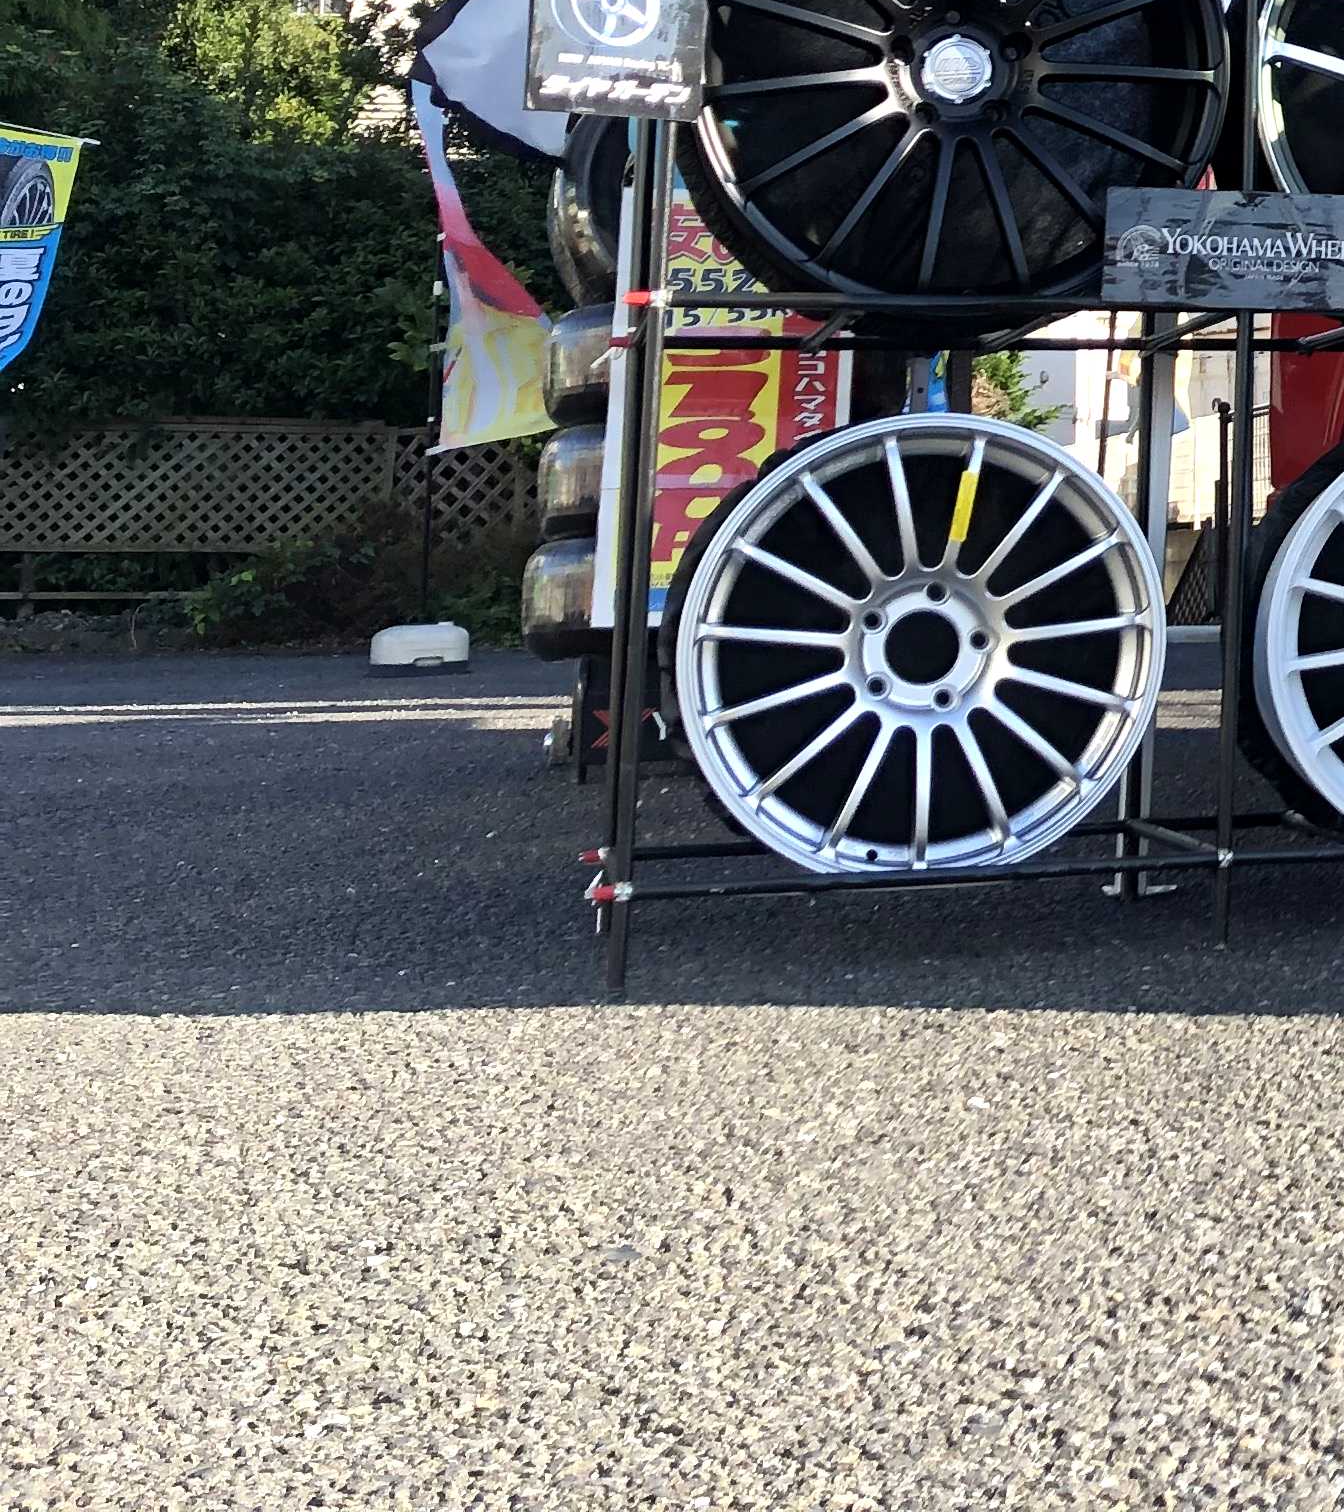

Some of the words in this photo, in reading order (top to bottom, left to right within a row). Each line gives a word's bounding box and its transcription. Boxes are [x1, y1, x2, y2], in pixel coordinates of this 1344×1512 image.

[1160, 227, 1286, 257] YOKOHAMA
[1208, 257, 1273, 273] ORIGINAL
[1272, 259, 1320, 274] DESIGN
